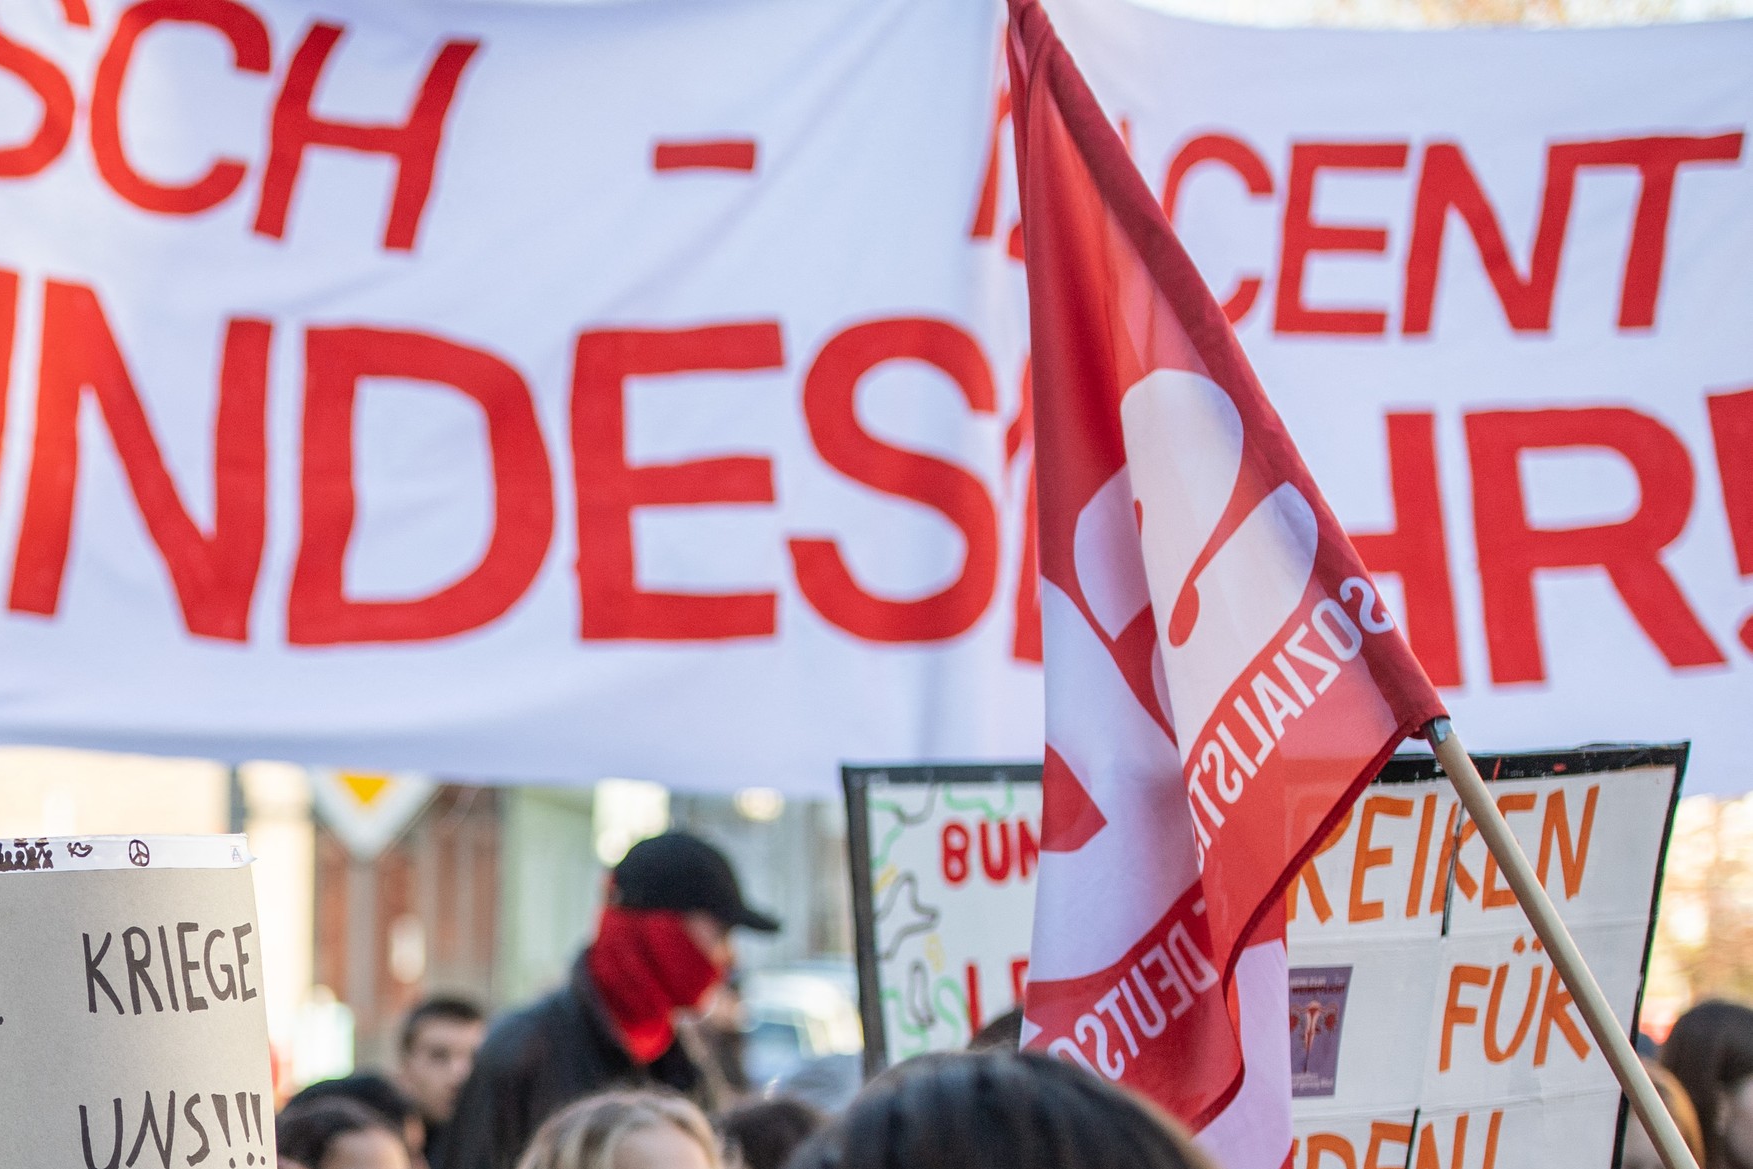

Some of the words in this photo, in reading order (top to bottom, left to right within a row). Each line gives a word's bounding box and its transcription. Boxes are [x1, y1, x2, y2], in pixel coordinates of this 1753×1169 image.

[1286, 784, 1600, 924] REIKEN
[82, 922, 257, 1016] KRIEGE
[1438, 936, 1591, 1073] FÜR
